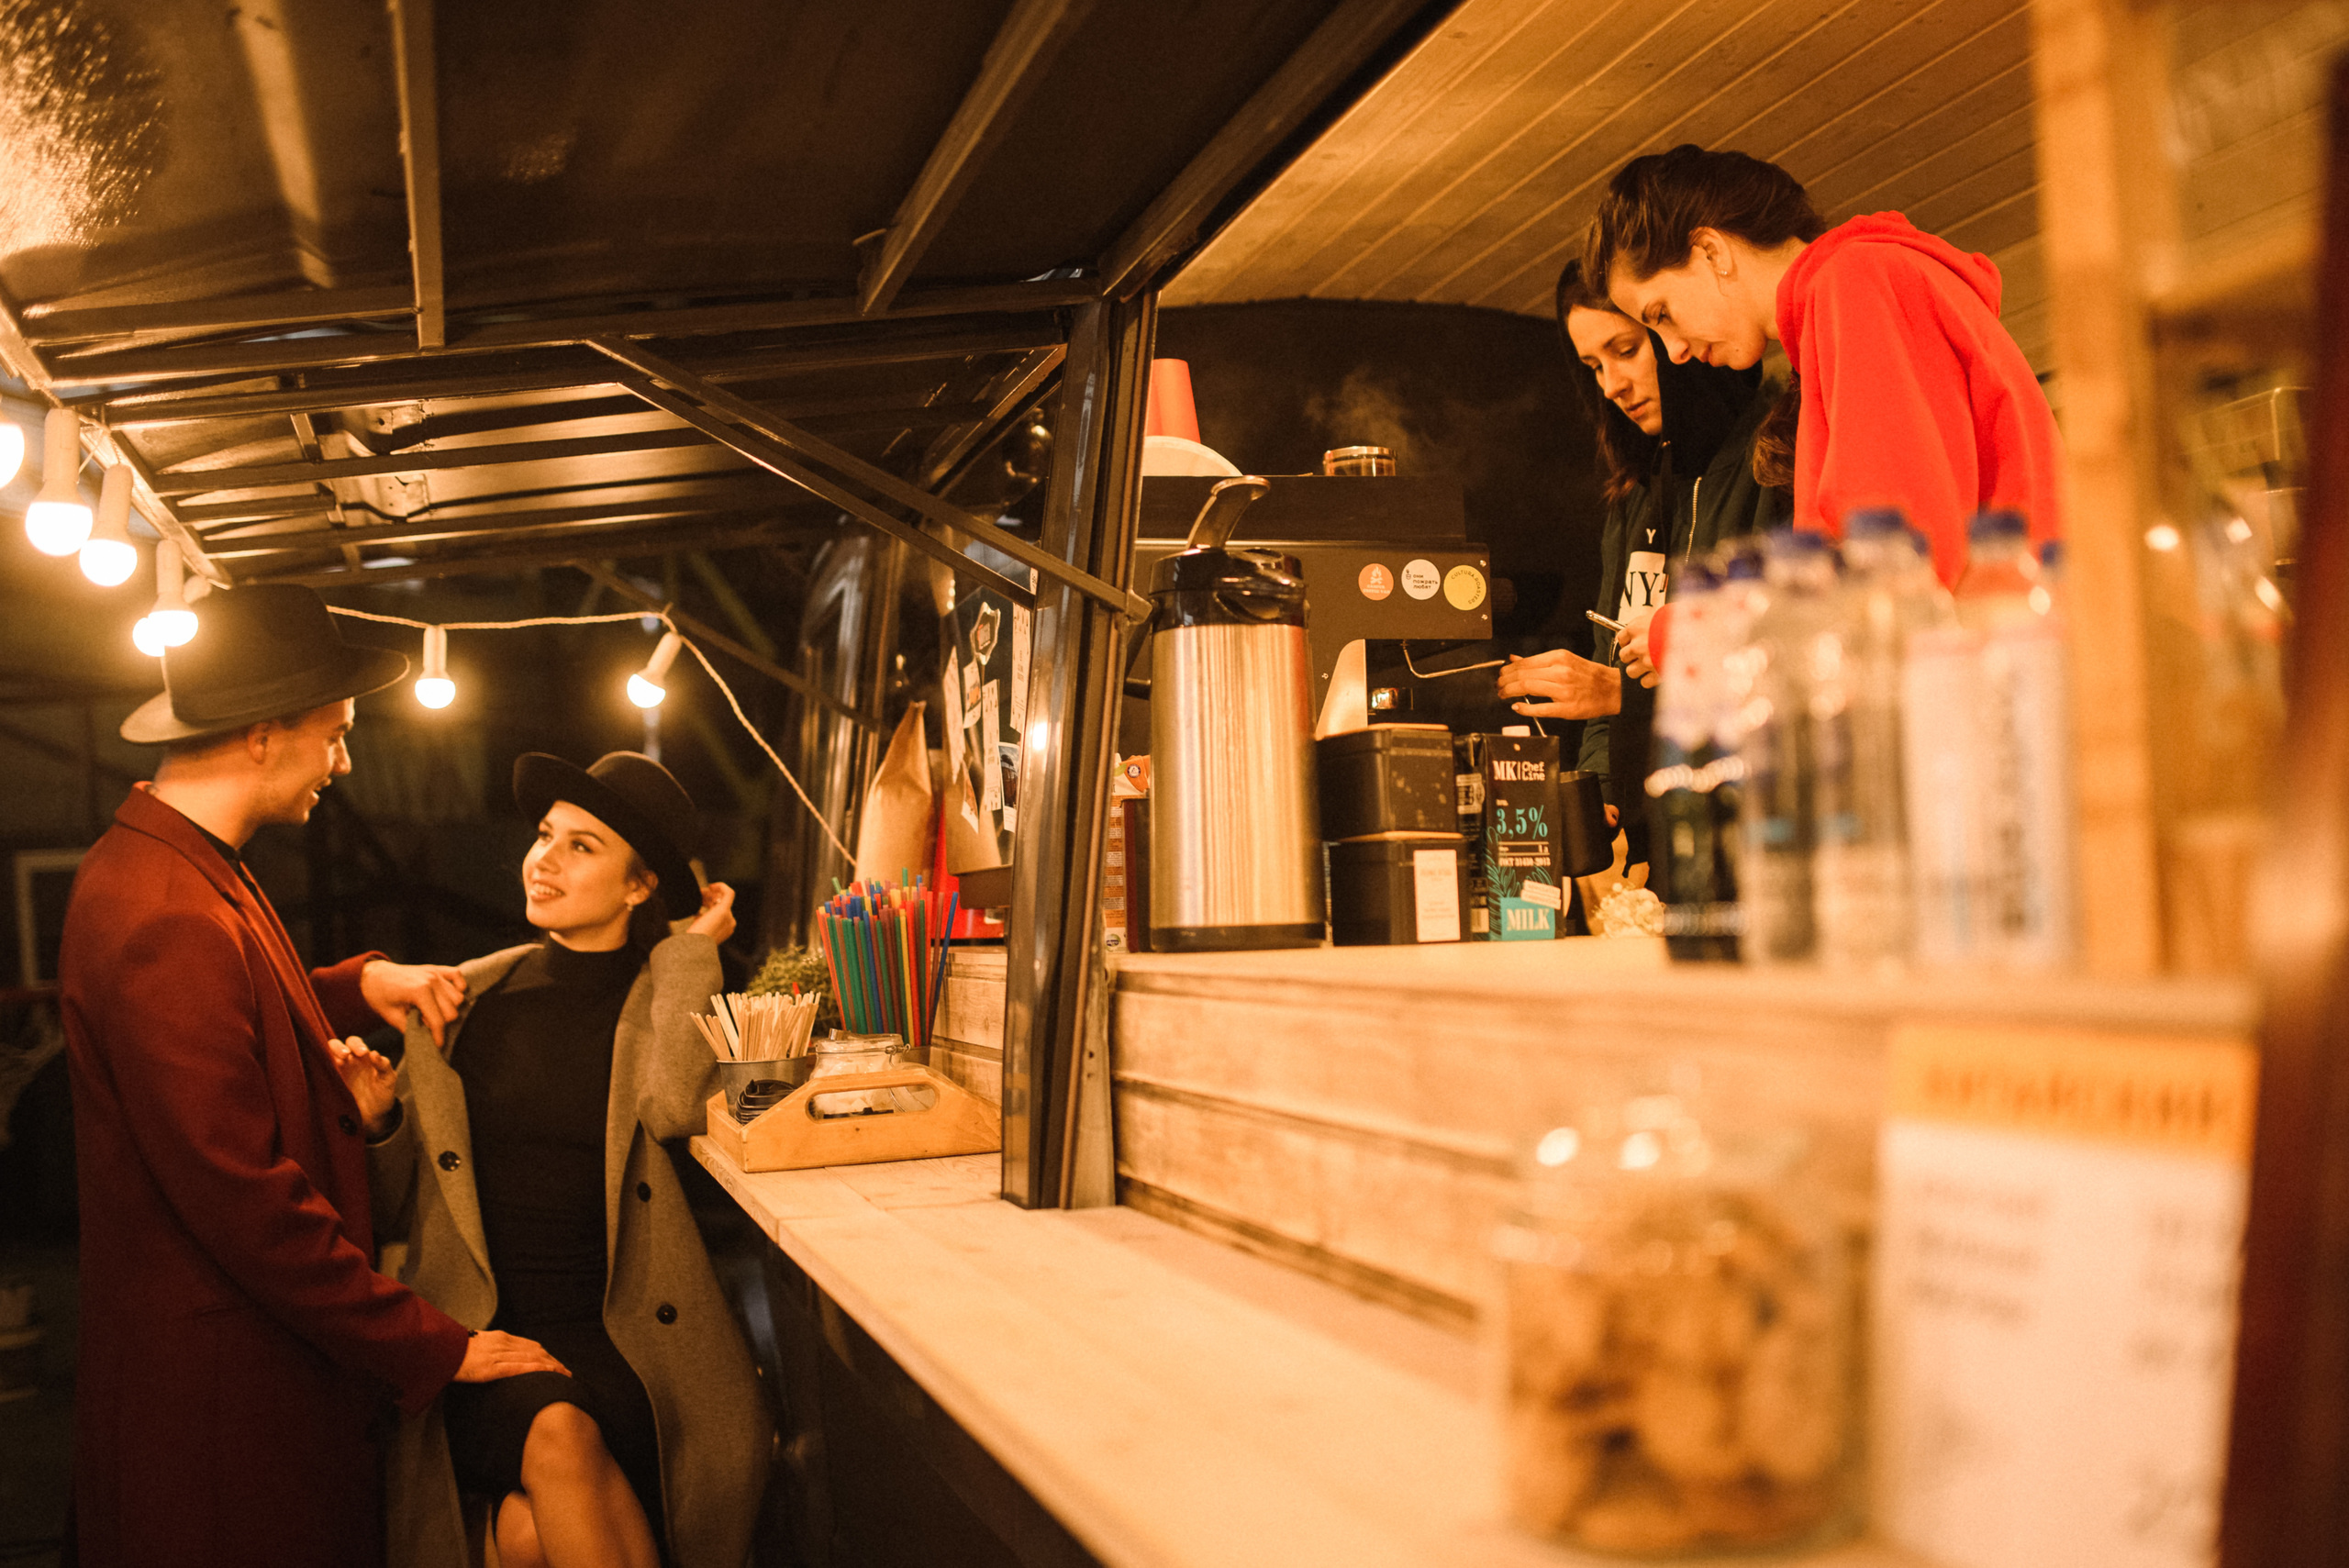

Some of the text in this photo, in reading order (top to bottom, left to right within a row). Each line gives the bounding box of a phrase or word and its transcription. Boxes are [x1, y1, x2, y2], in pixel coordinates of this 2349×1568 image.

[1492, 760, 1518, 782] MK
[1521, 761, 1545, 772] Chef
[1522, 771, 1545, 782] Line
[1496, 804, 1548, 840] 3,5%
[1506, 907, 1550, 931] MILK
